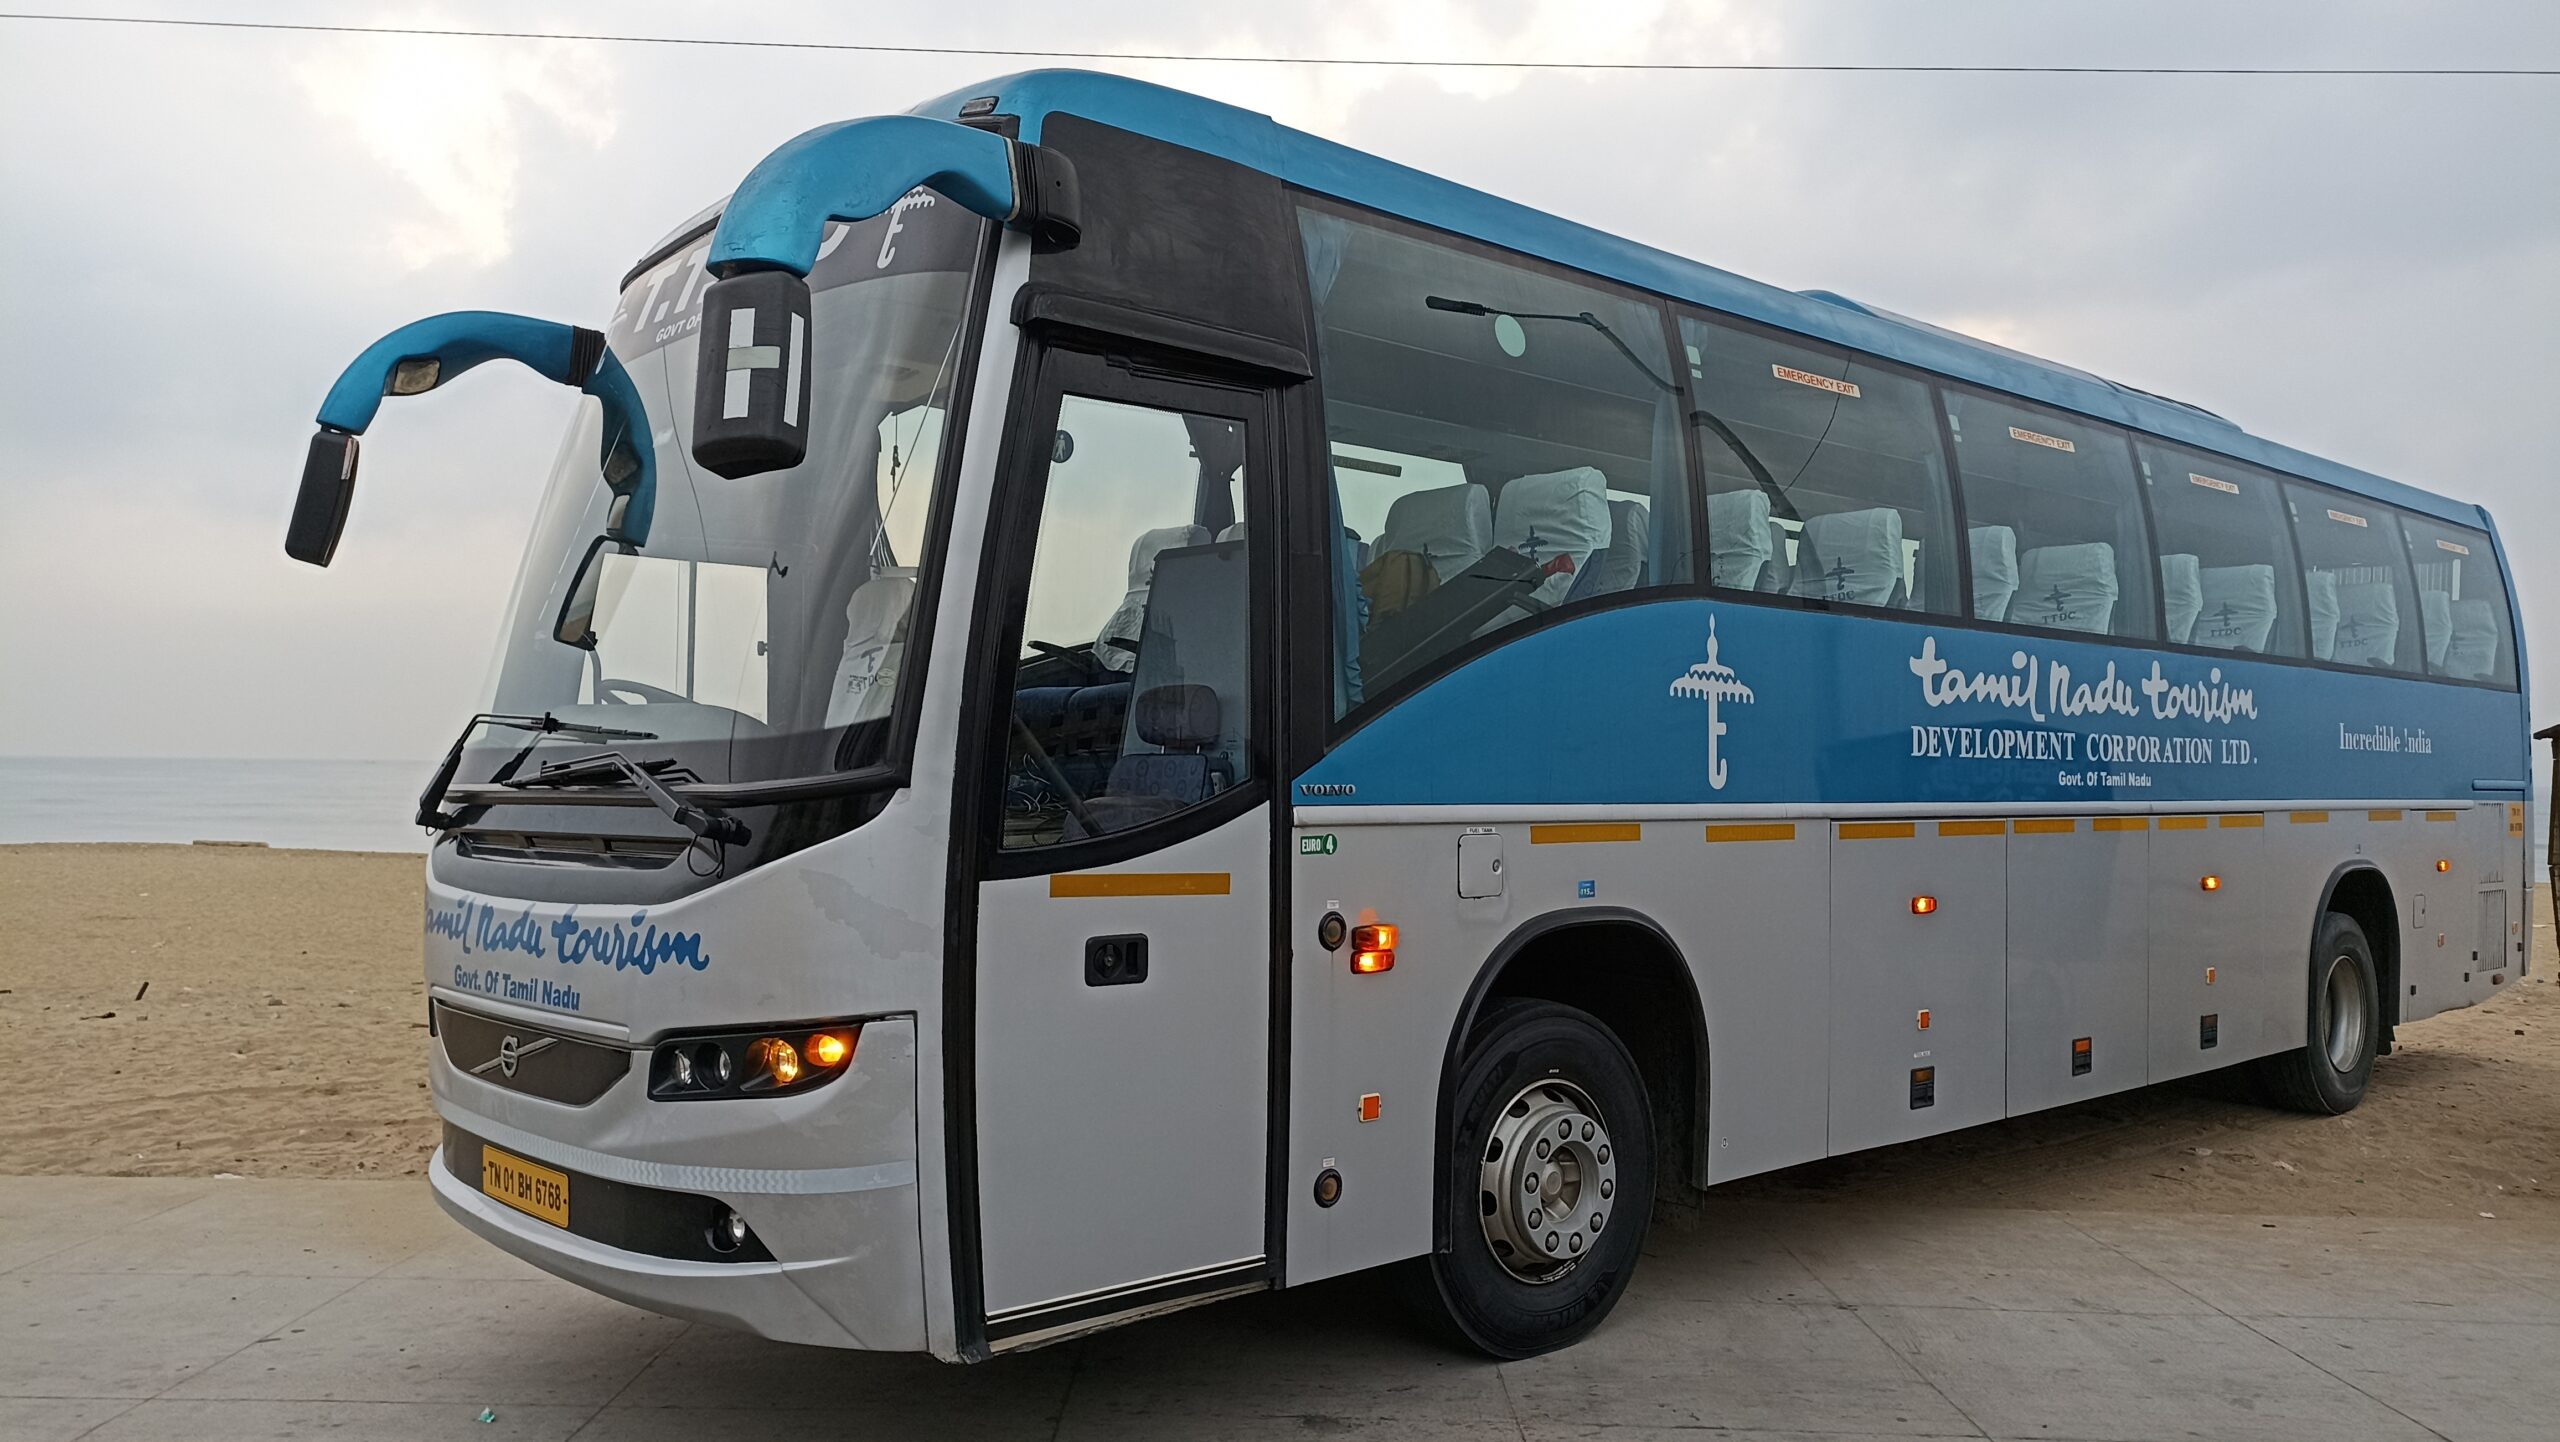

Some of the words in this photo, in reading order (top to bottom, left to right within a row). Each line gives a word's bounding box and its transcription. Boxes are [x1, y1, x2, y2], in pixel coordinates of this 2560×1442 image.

[656, 319, 687, 343] GOVT
[1777, 367, 1834, 389] EMERGENCY
[1836, 382, 1855, 395] EXIT
[2041, 611, 2076, 624] TTDC
[2210, 627, 2241, 637] TTDC
[2141, 660, 2258, 724] tourism
[1911, 725, 2076, 761] DEVELOPMENT
[2086, 733, 2212, 764] CORPORATION
[2221, 739, 2258, 764] LTD.
[2339, 722, 2400, 753] Incredible
[1300, 784, 1356, 796] VOLVO
[2058, 770, 2084, 786] Govt.
[2086, 771, 2098, 786] Of
[2100, 772, 2126, 787] Tamil
[2128, 772, 2152, 787] Nadu
[1301, 838, 1321, 852] EURO
[1326, 835, 1334, 854] 4
[425, 895, 476, 954] amil
[551, 904, 710, 976] tourism
[454, 964, 481, 990] Govt.
[485, 970, 500, 994] Of
[502, 972, 538, 1002] Tamil
[542, 980, 580, 1011] Nadu
[488, 1161, 501, 1189] TN
[503, 1166, 514, 1194] 01
[518, 1172, 532, 1201] BH
[535, 1178, 561, 1211] 6768
